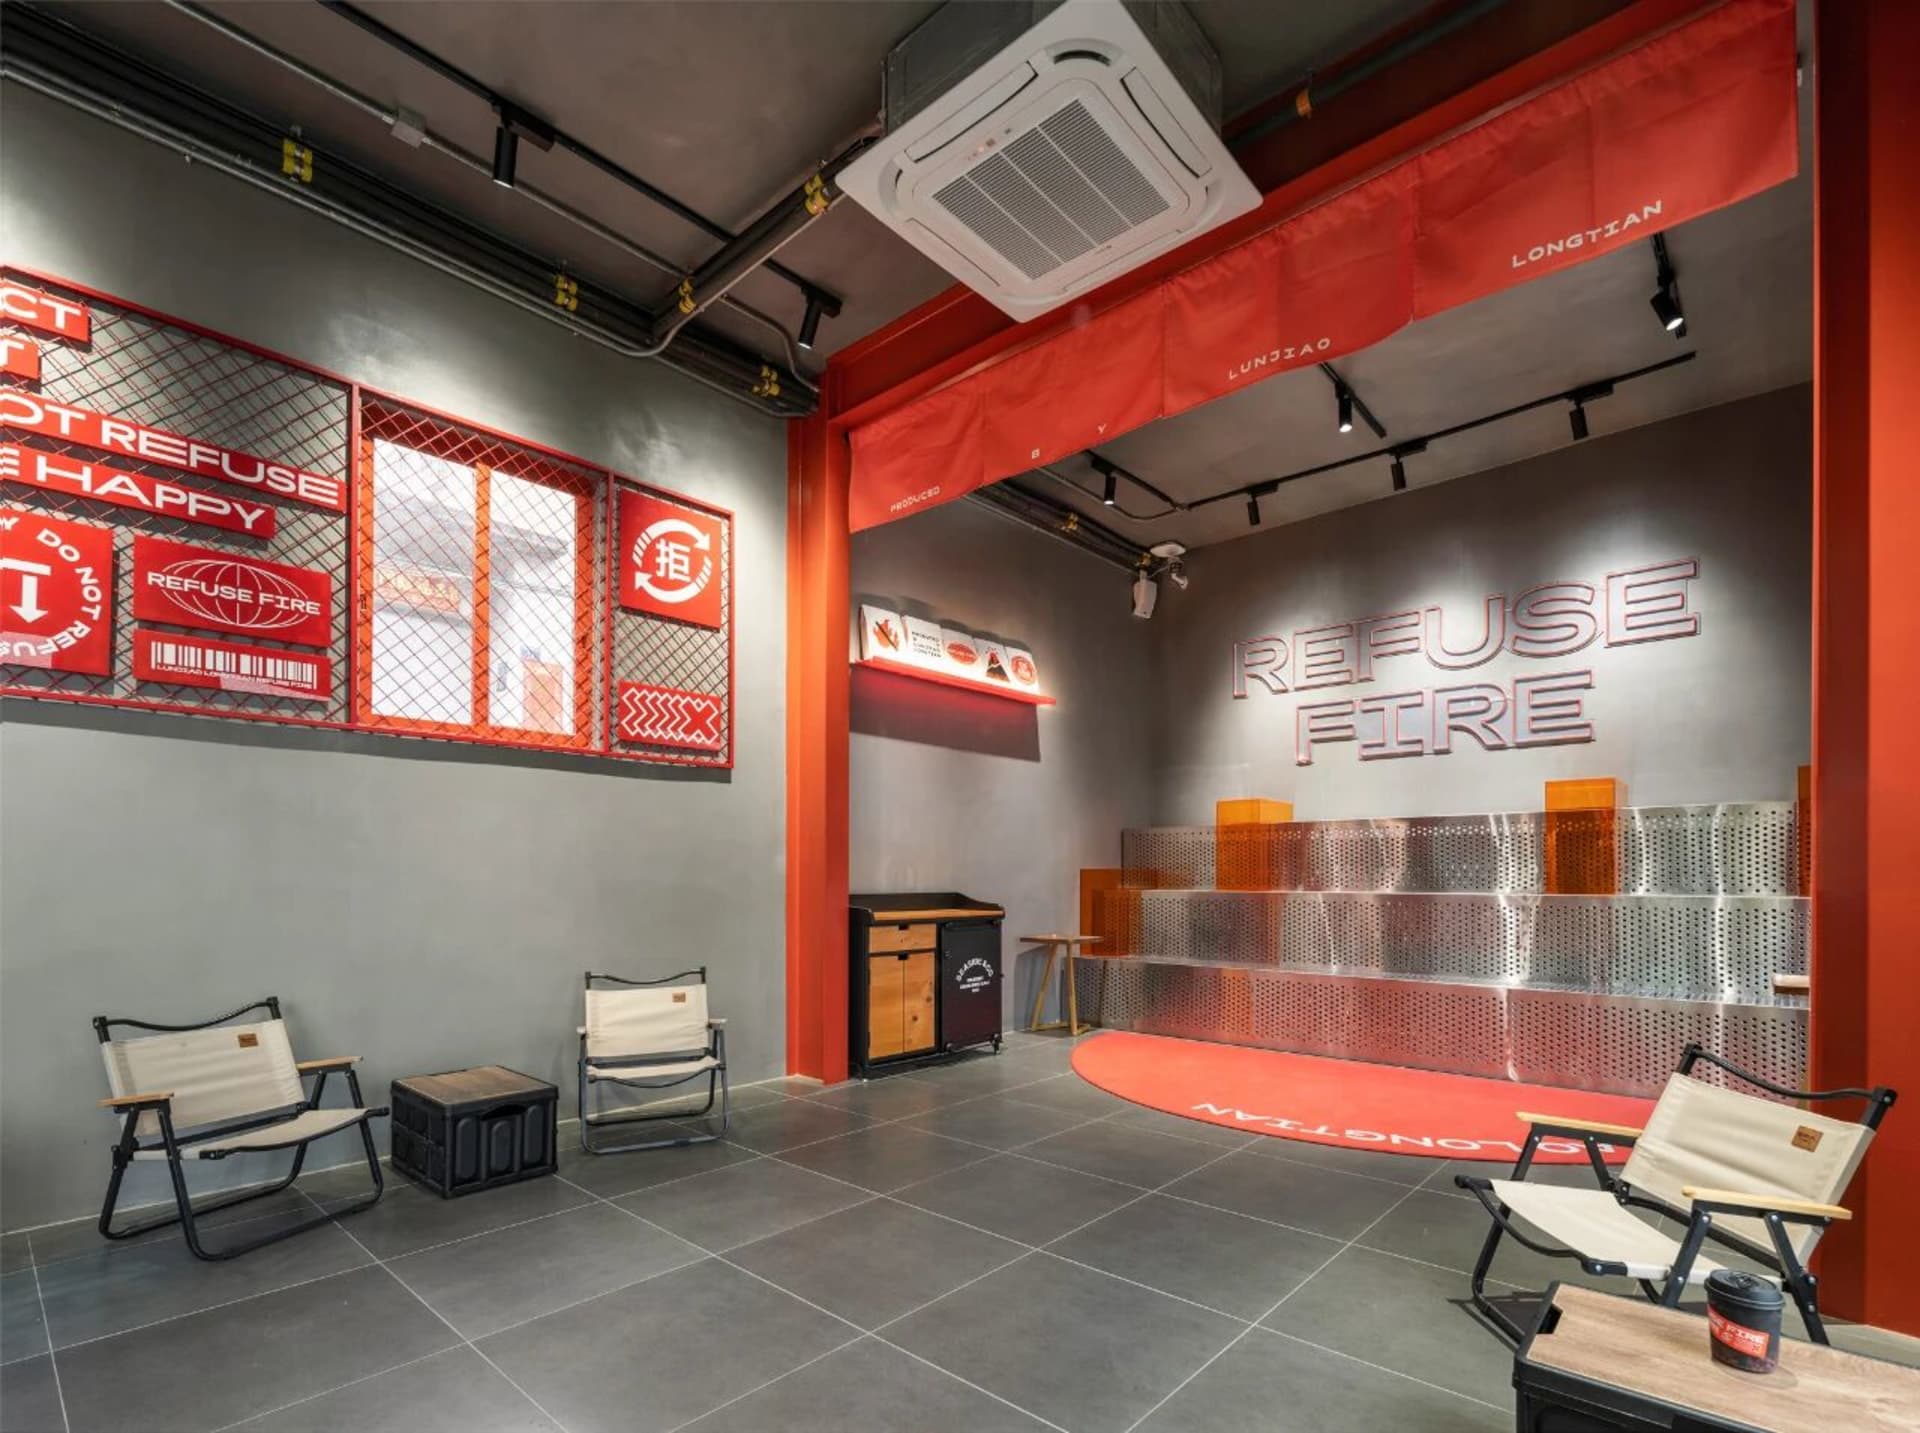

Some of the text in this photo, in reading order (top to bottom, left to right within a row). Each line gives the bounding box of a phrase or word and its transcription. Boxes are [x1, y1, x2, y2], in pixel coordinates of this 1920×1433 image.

[1512, 200, 1663, 269] LONGTIAN
[1229, 337, 1332, 381] LUNJIAO
[36, 455, 265, 530] HAPPY
[101, 418, 339, 506] REFUSE
[890, 485, 941, 513] PRODUCED
[36, 528, 81, 562] DO
[74, 566, 102, 621] NOT
[146, 571, 321, 616] REFUSE FIRE
[654, 538, 692, 584] 拒
[1232, 558, 1699, 699] REFUSE
[1296, 669, 1595, 766] FIRE
[1191, 1102, 1523, 1153] LONGTIAN
